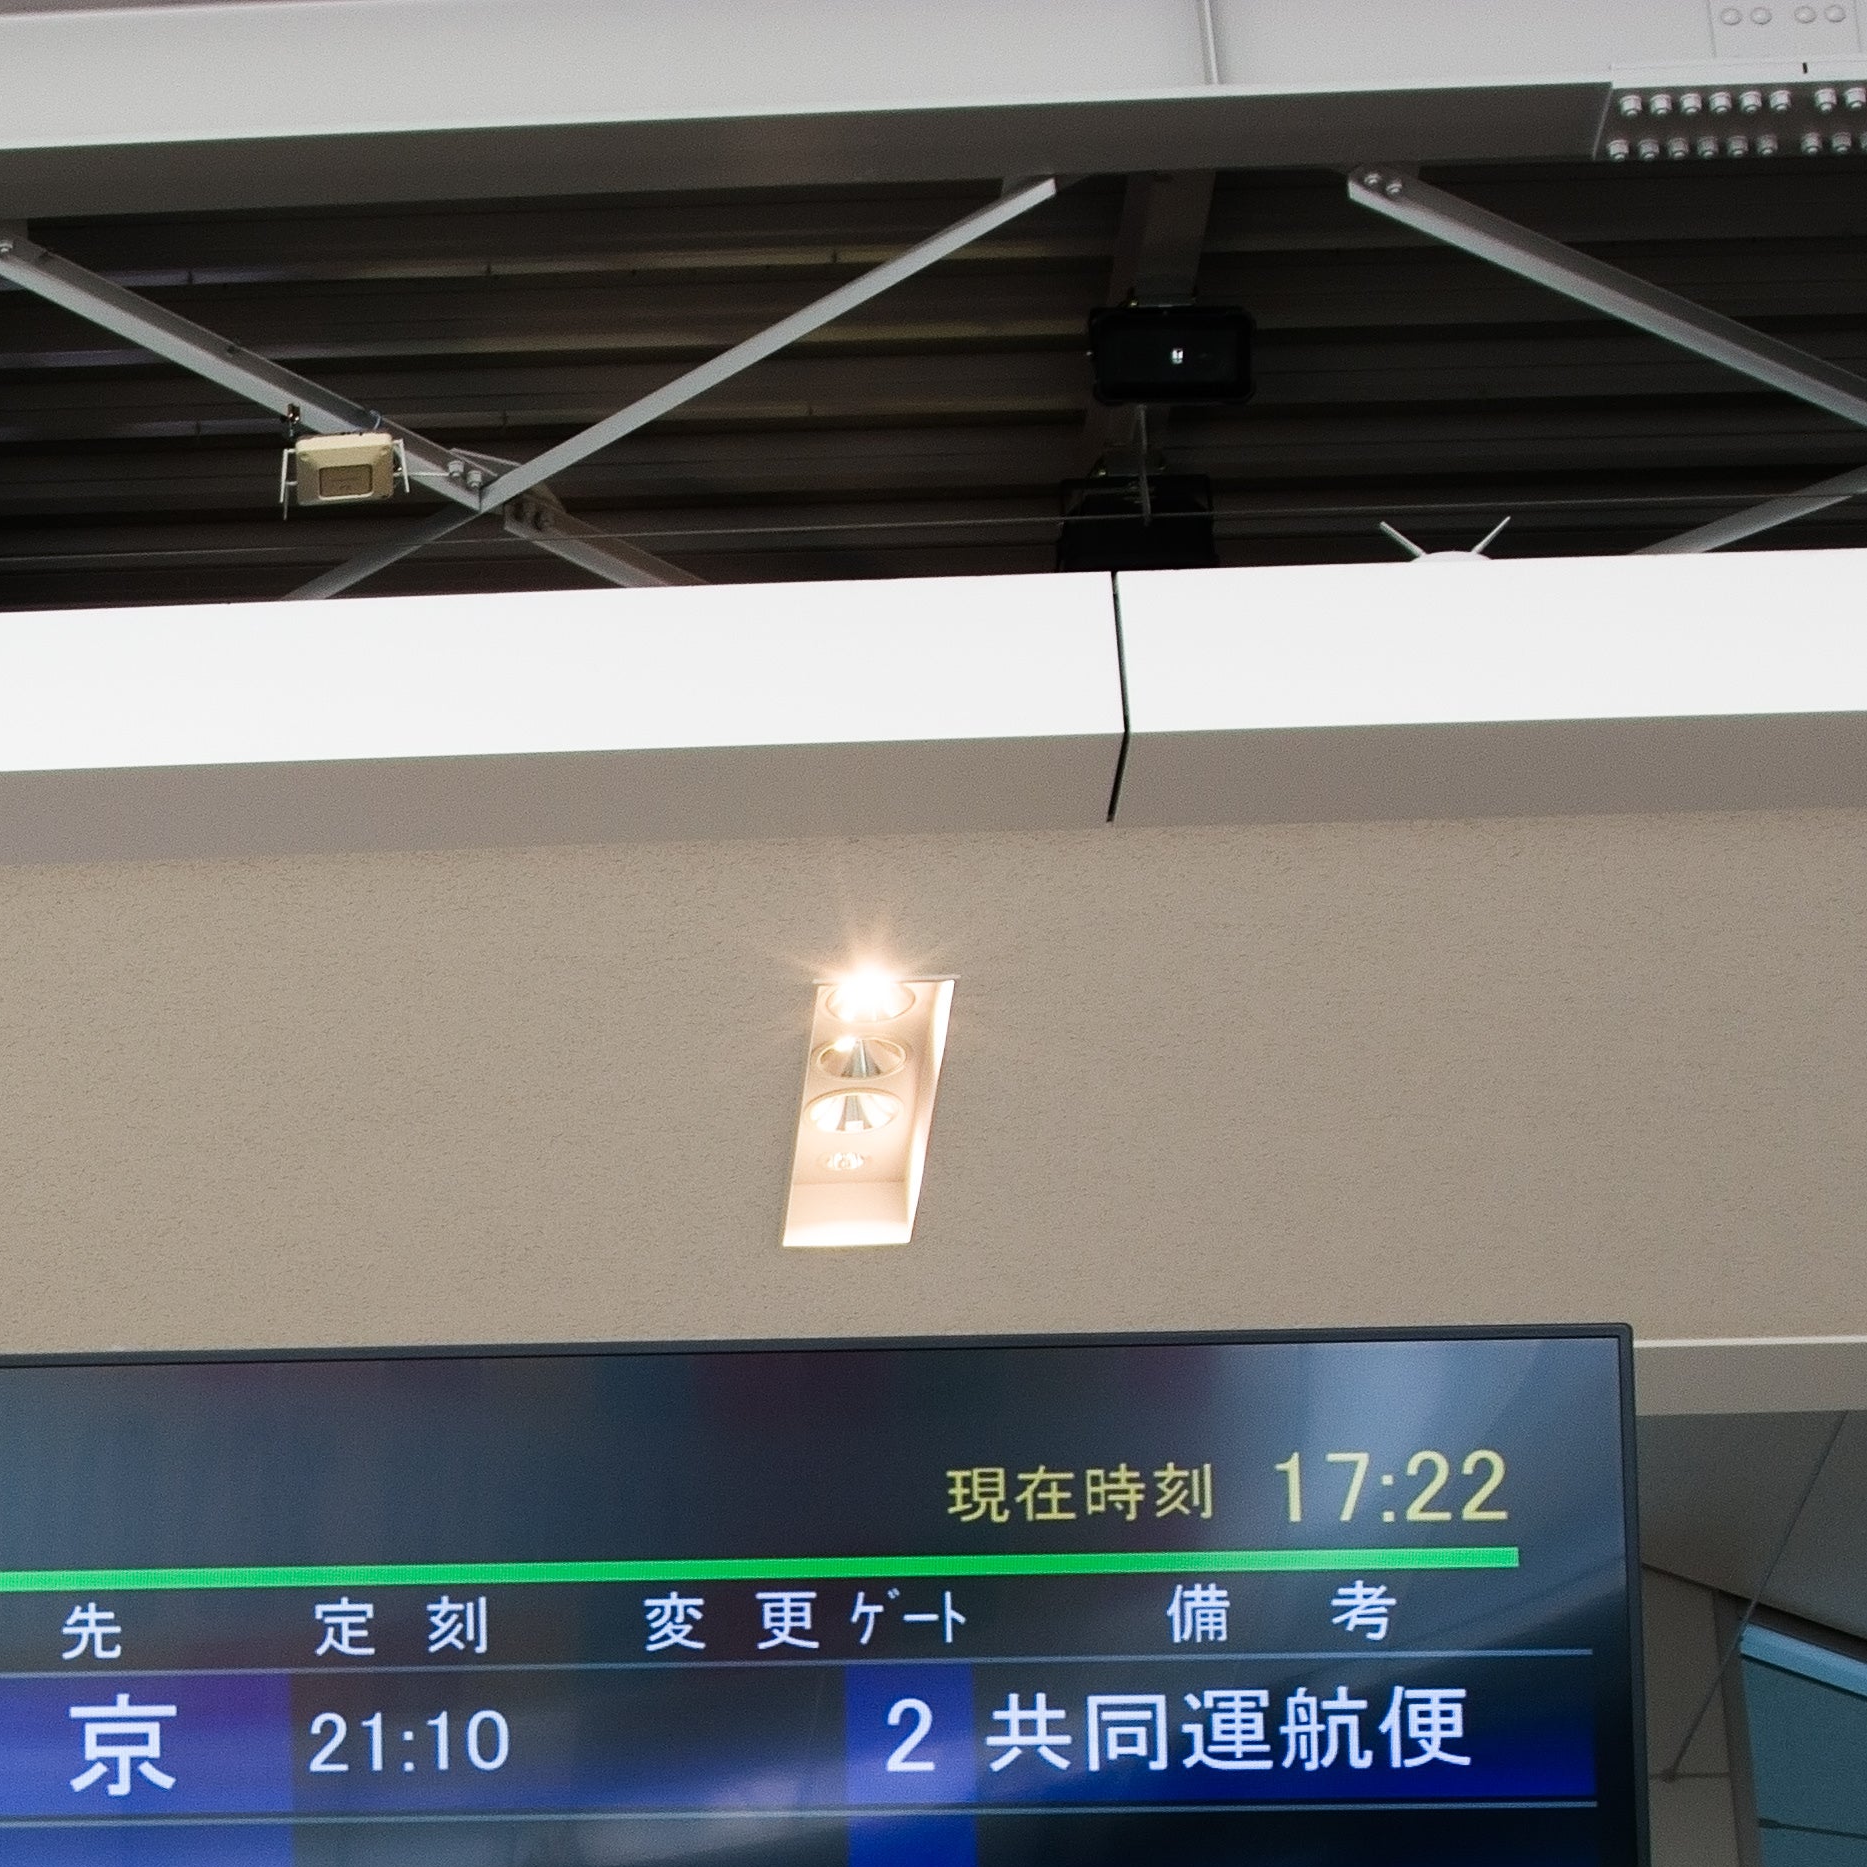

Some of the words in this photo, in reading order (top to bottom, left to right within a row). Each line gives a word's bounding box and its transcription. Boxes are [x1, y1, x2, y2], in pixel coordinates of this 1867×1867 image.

[946, 1462, 1212, 1523] 現在時刻
[1275, 1449, 1508, 1523] 17:22
[314, 1595, 488, 1656] 定刻
[644, 1591, 820, 1652] 変更
[1166, 1579, 1397, 1643] 備考
[309, 1710, 509, 1772] 21:10
[886, 1698, 935, 1773] 2
[986, 1685, 1471, 1772] 共同運航便
